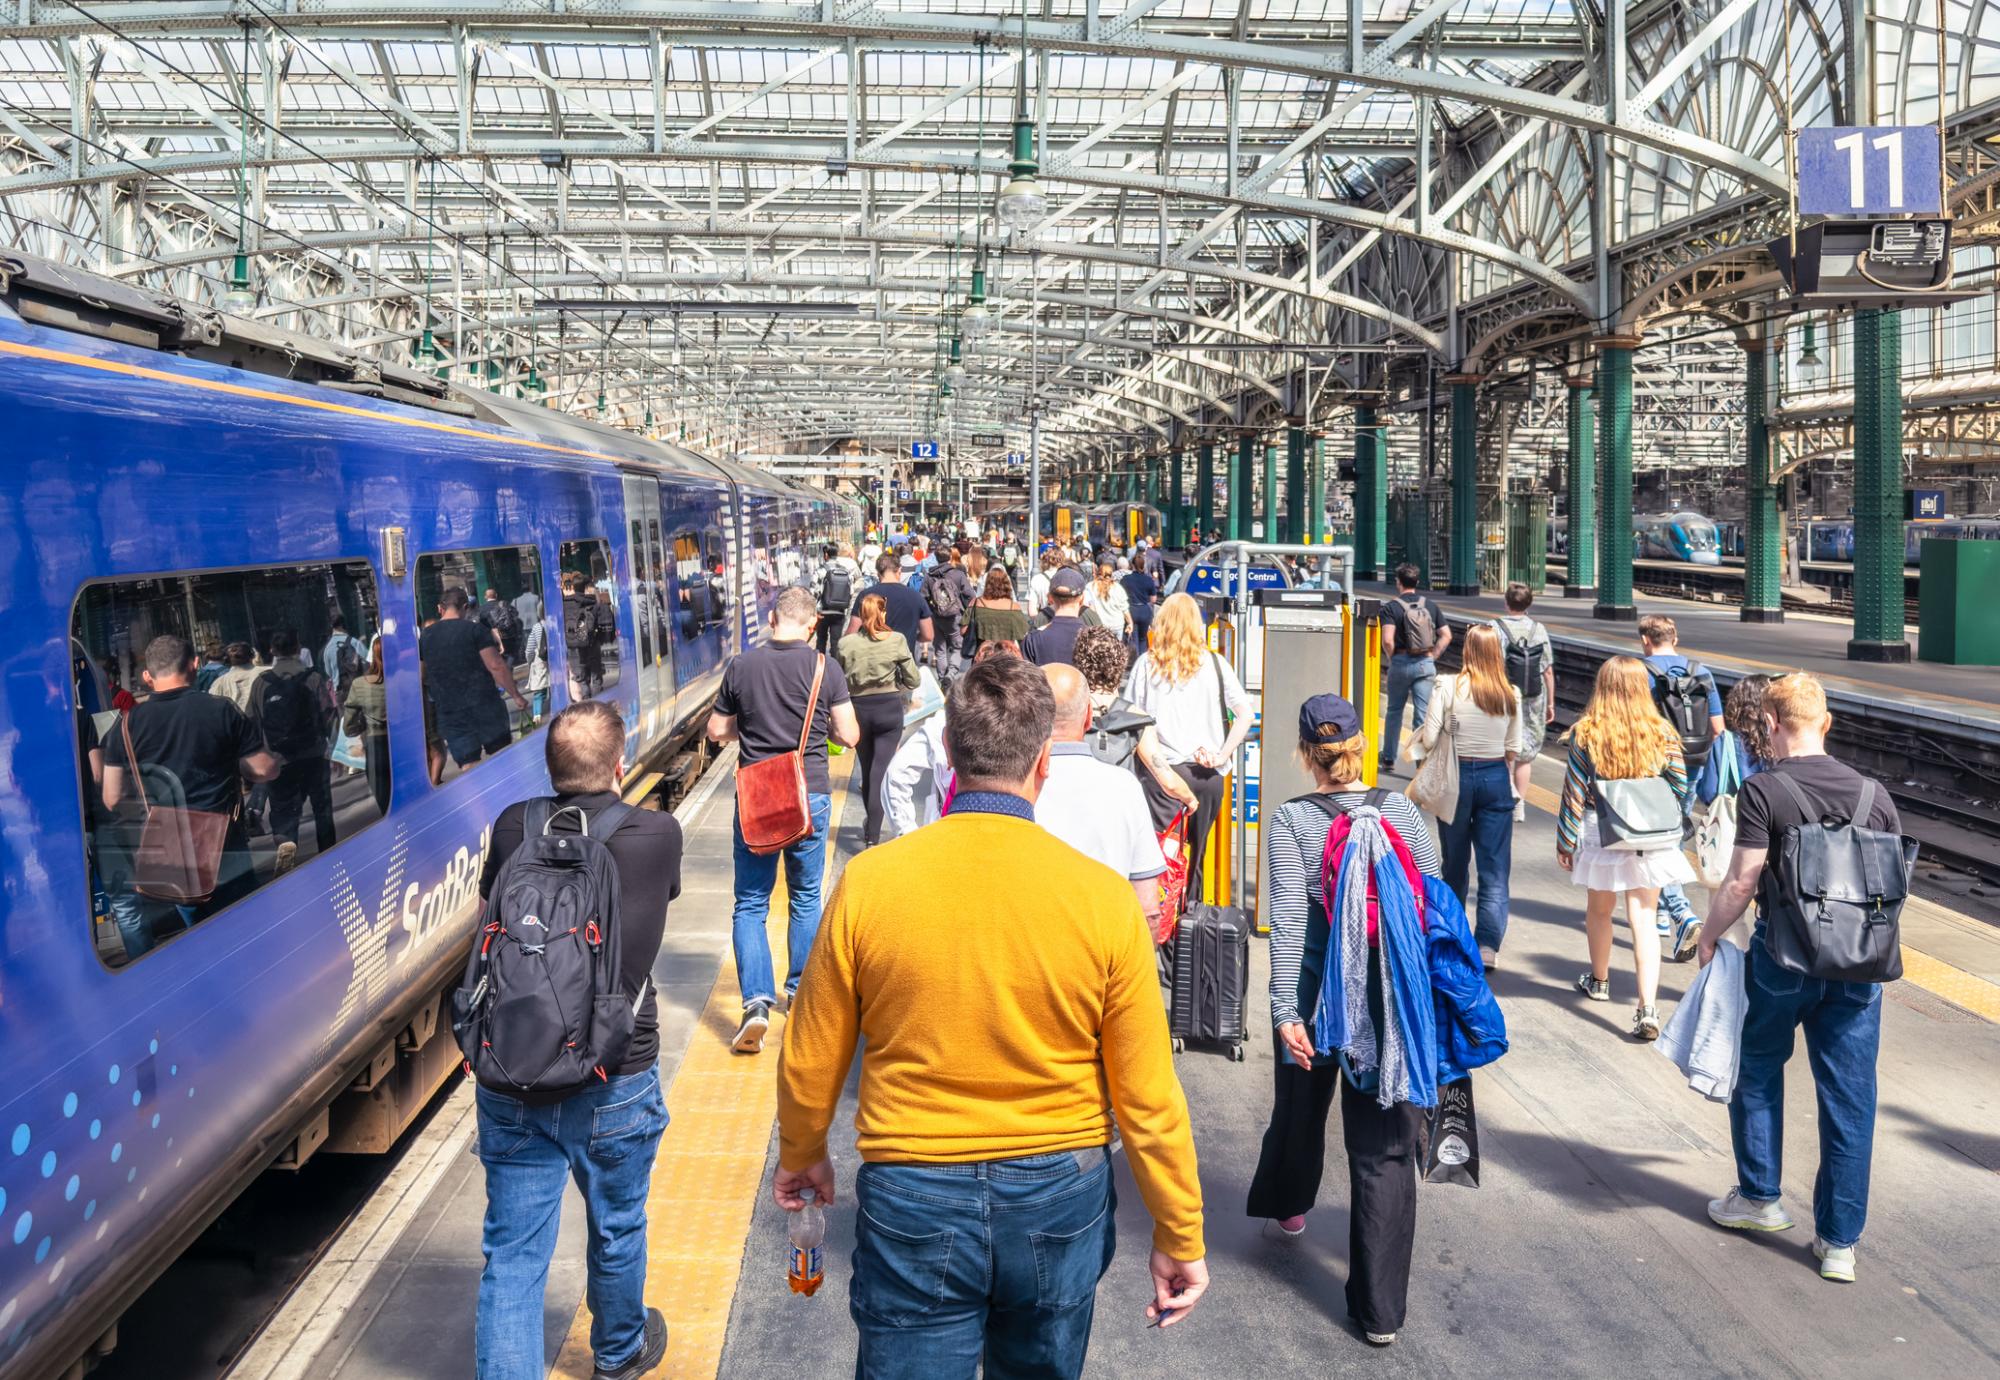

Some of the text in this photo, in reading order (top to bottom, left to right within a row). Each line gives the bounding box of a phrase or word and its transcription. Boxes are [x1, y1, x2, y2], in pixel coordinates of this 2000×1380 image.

[1834, 132, 1903, 208] 11
[917, 444, 932, 457] 12
[1011, 454, 1021, 464] 11
[900, 491, 908, 499] 12
[1248, 572, 1277, 581] Central
[396, 823, 490, 964] ScotRail
[1445, 1087, 1467, 1108] M&S
